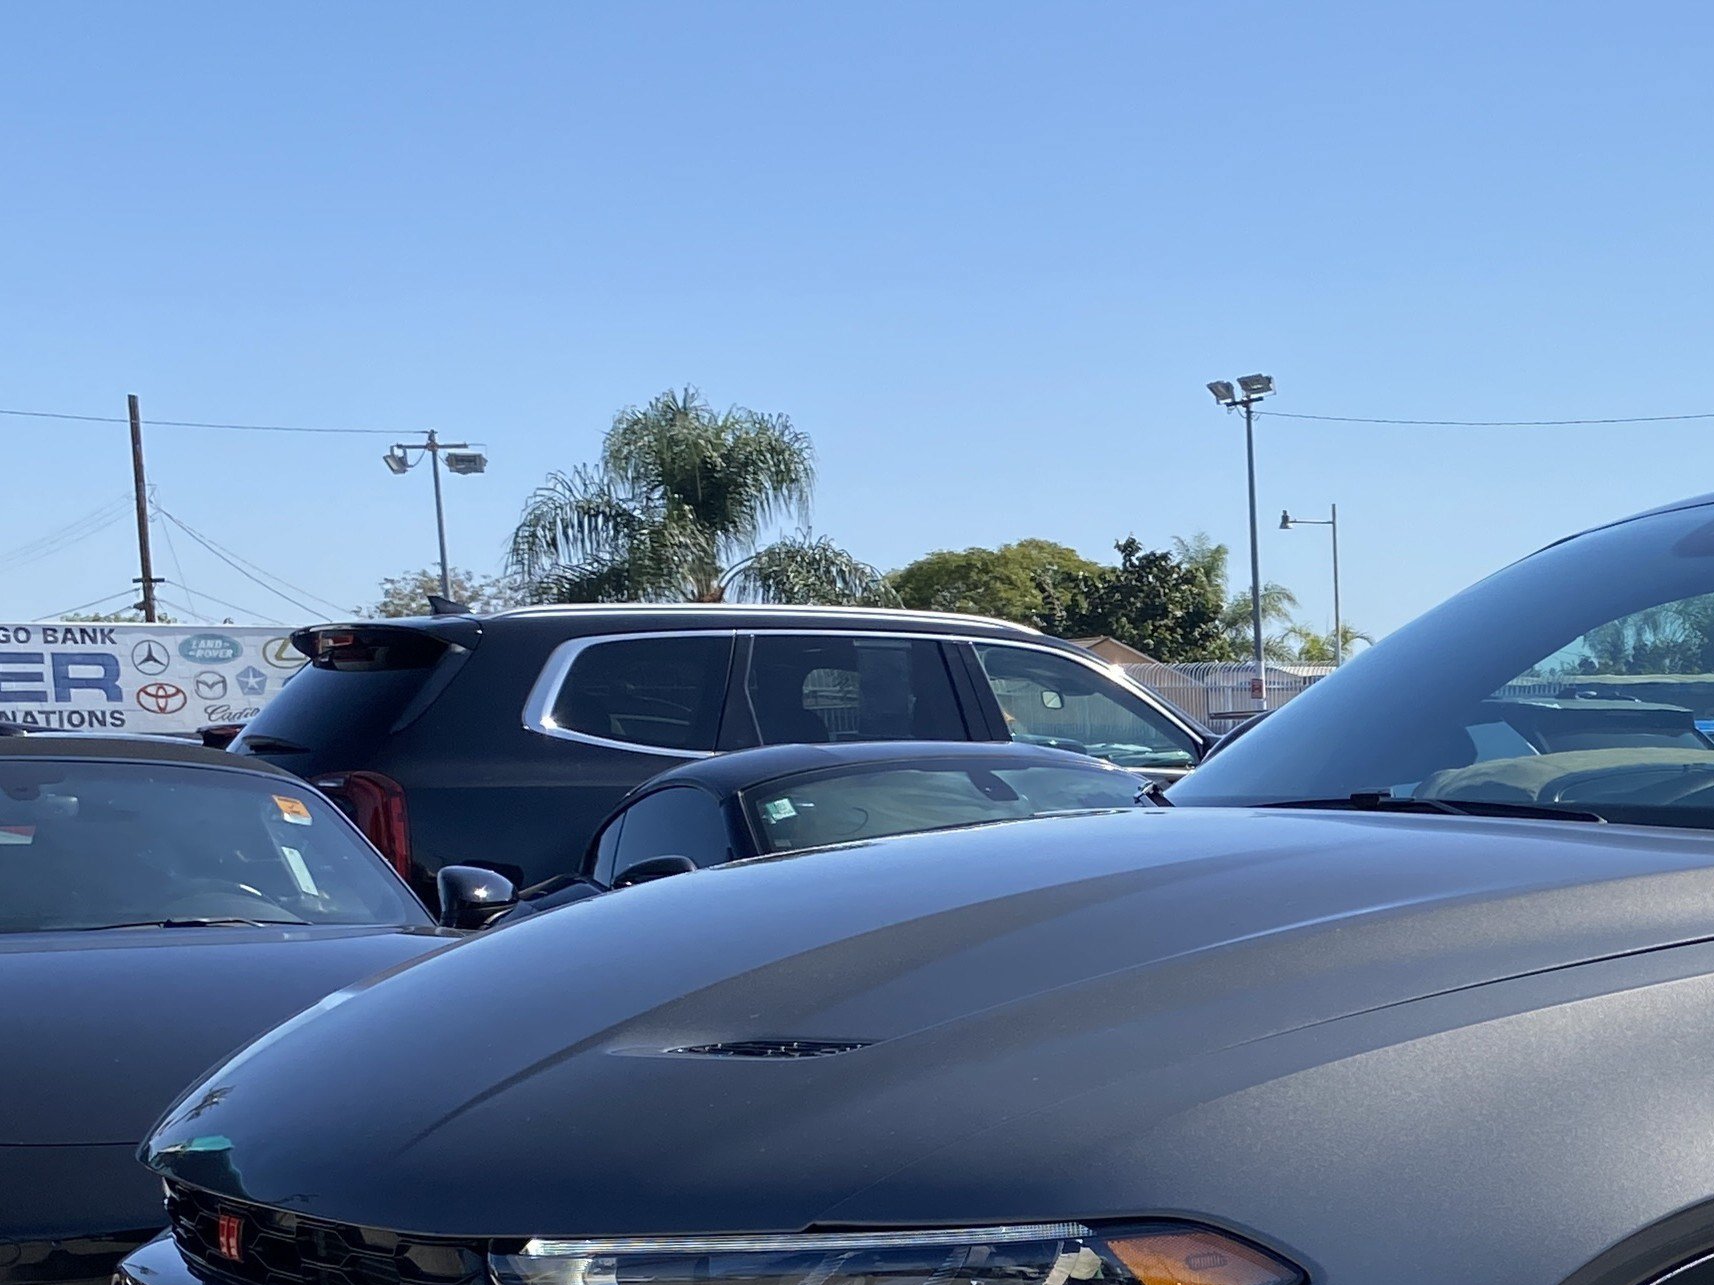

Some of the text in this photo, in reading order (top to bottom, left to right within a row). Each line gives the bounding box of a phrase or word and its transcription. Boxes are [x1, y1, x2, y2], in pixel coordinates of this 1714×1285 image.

[42, 627, 118, 645] BANK
[191, 640, 222, 649] LAND
[194, 649, 234, 658] ROVER
[0, 652, 123, 703] ER
